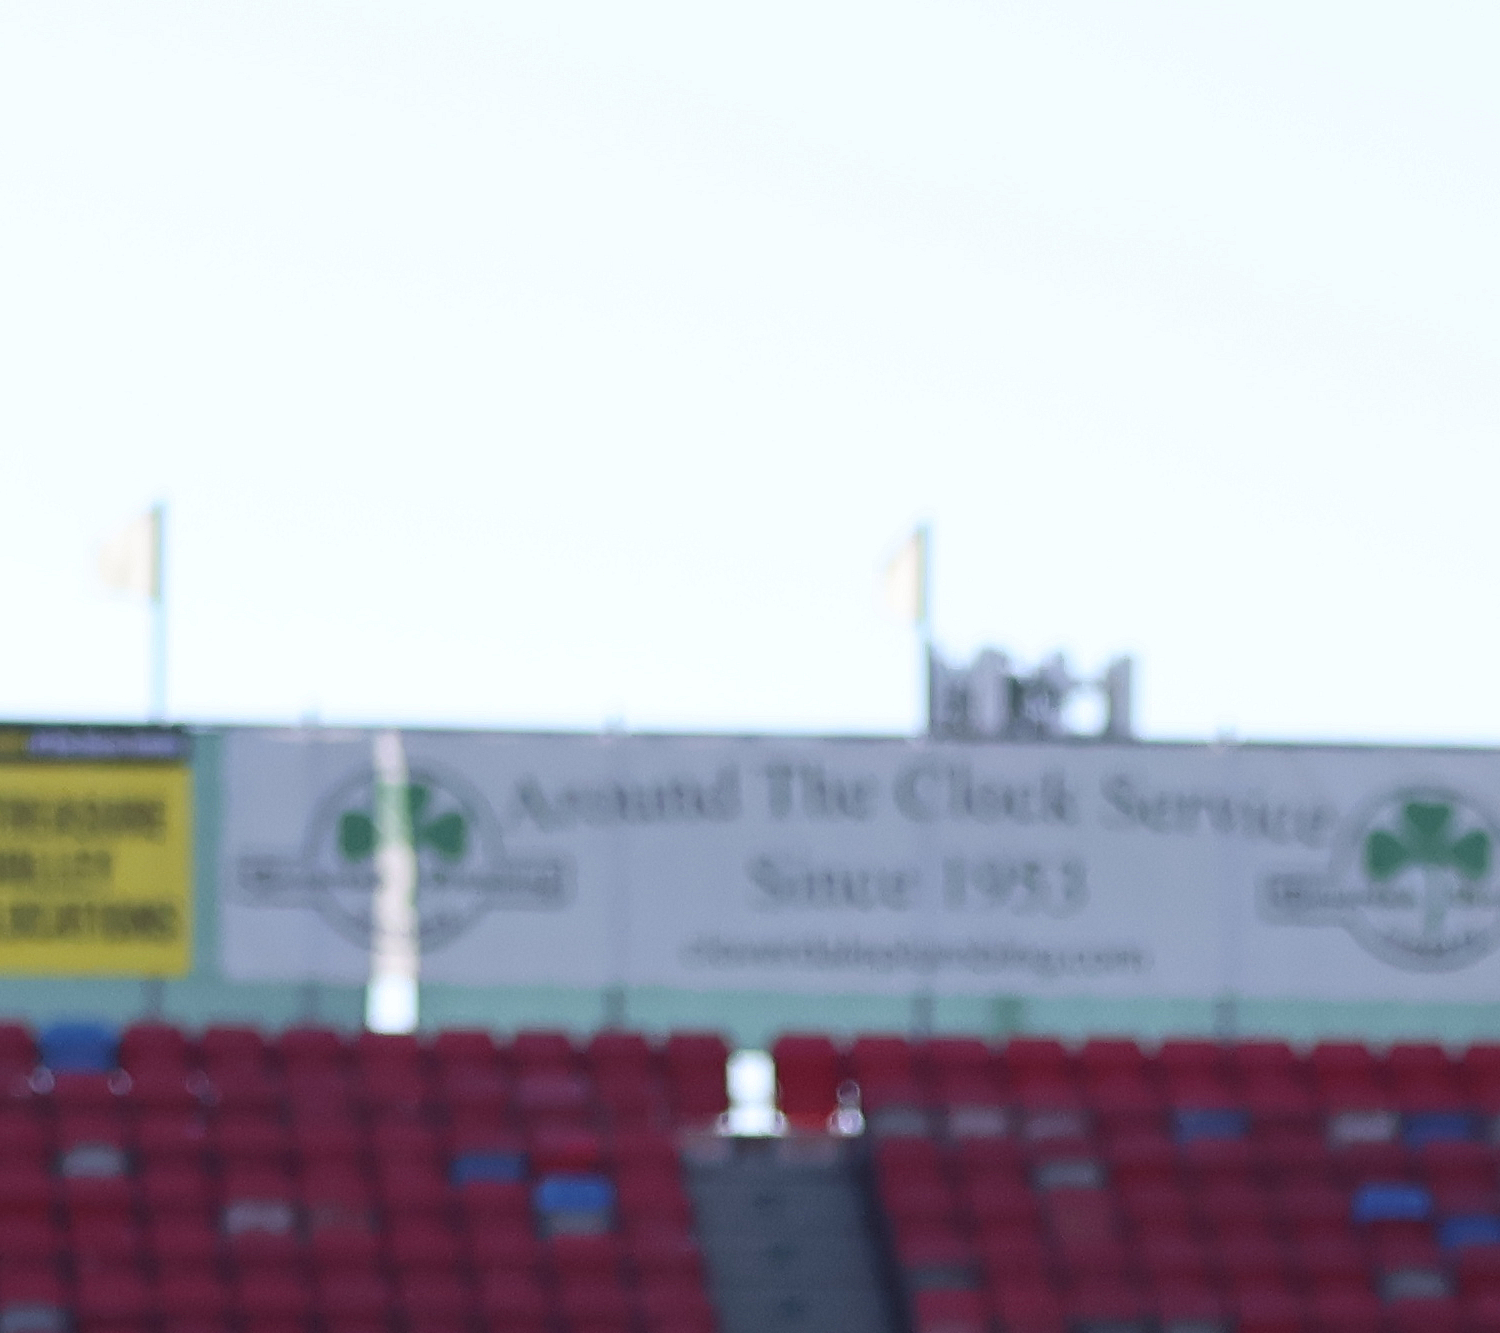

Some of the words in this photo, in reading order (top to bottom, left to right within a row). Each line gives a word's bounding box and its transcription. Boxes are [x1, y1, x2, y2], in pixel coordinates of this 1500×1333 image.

[758, 760, 878, 822] The
[894, 760, 1074, 825] Clock
[1102, 768, 1348, 848] Service
[744, 853, 924, 914] Since
